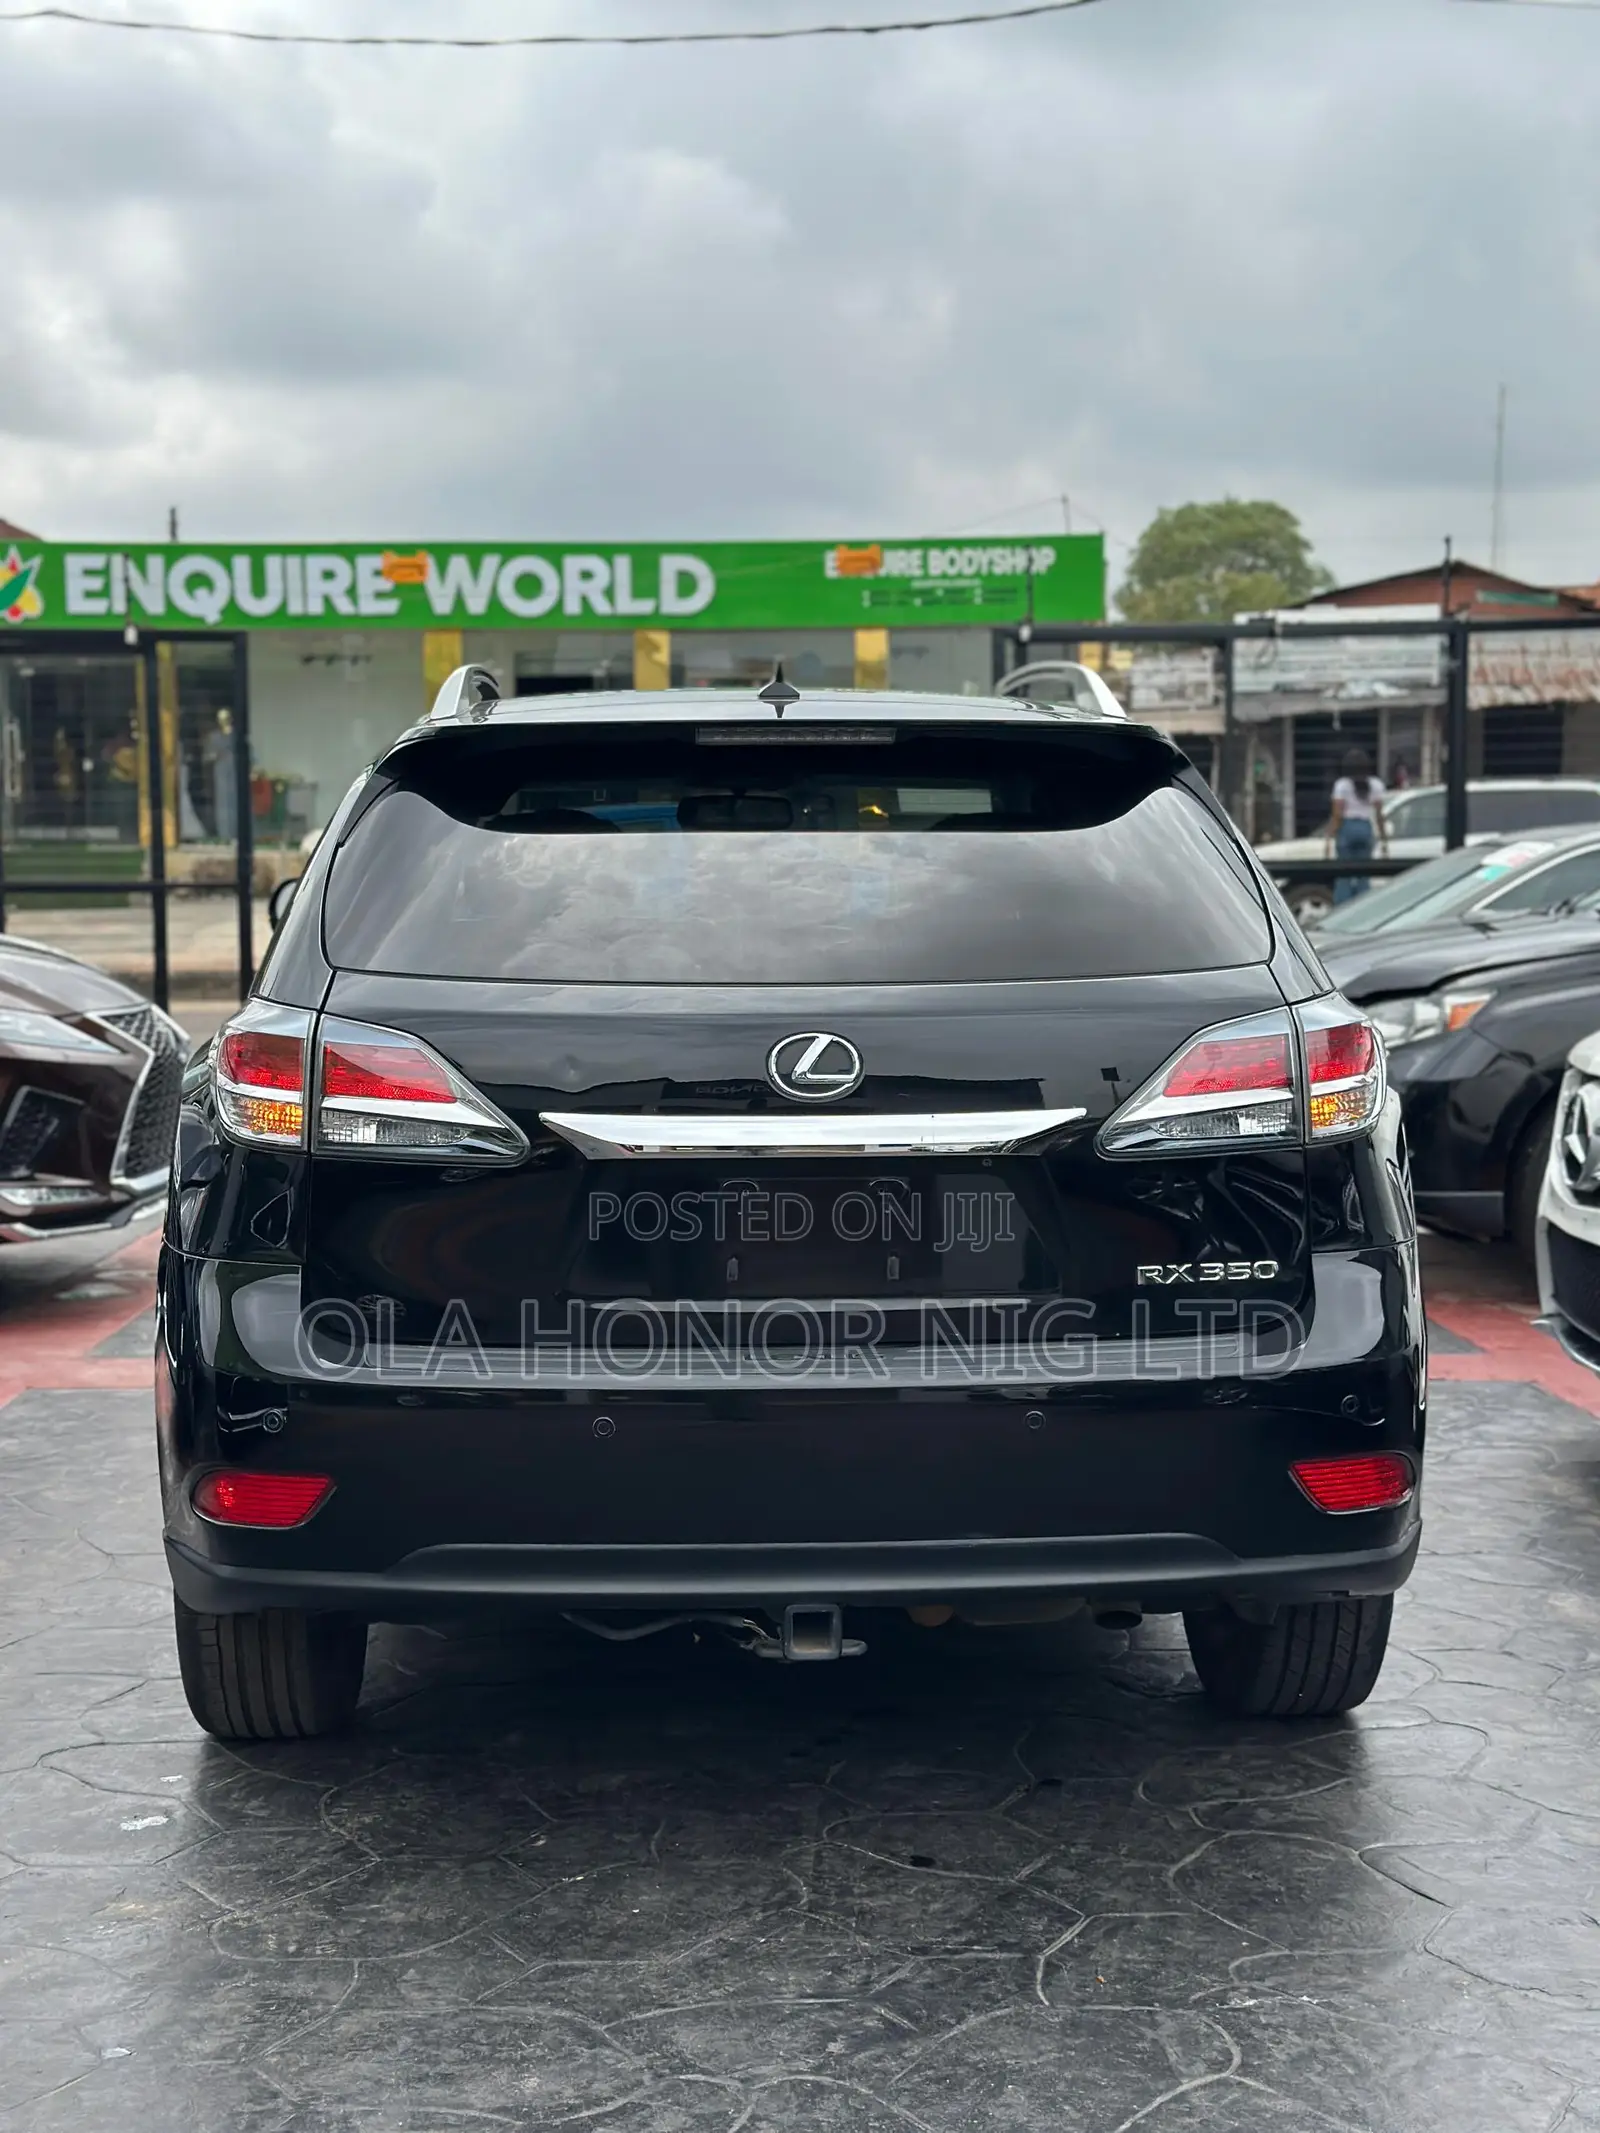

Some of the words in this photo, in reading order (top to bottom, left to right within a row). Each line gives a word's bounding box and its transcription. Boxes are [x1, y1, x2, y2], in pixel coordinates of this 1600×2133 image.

[928, 545, 1056, 577] BODYSHOP
[64, 552, 401, 625] ENQUIRE
[423, 553, 716, 617] WORLD
[1136, 1263, 1195, 1285] RX
[1199, 1260, 1280, 1281] 350
